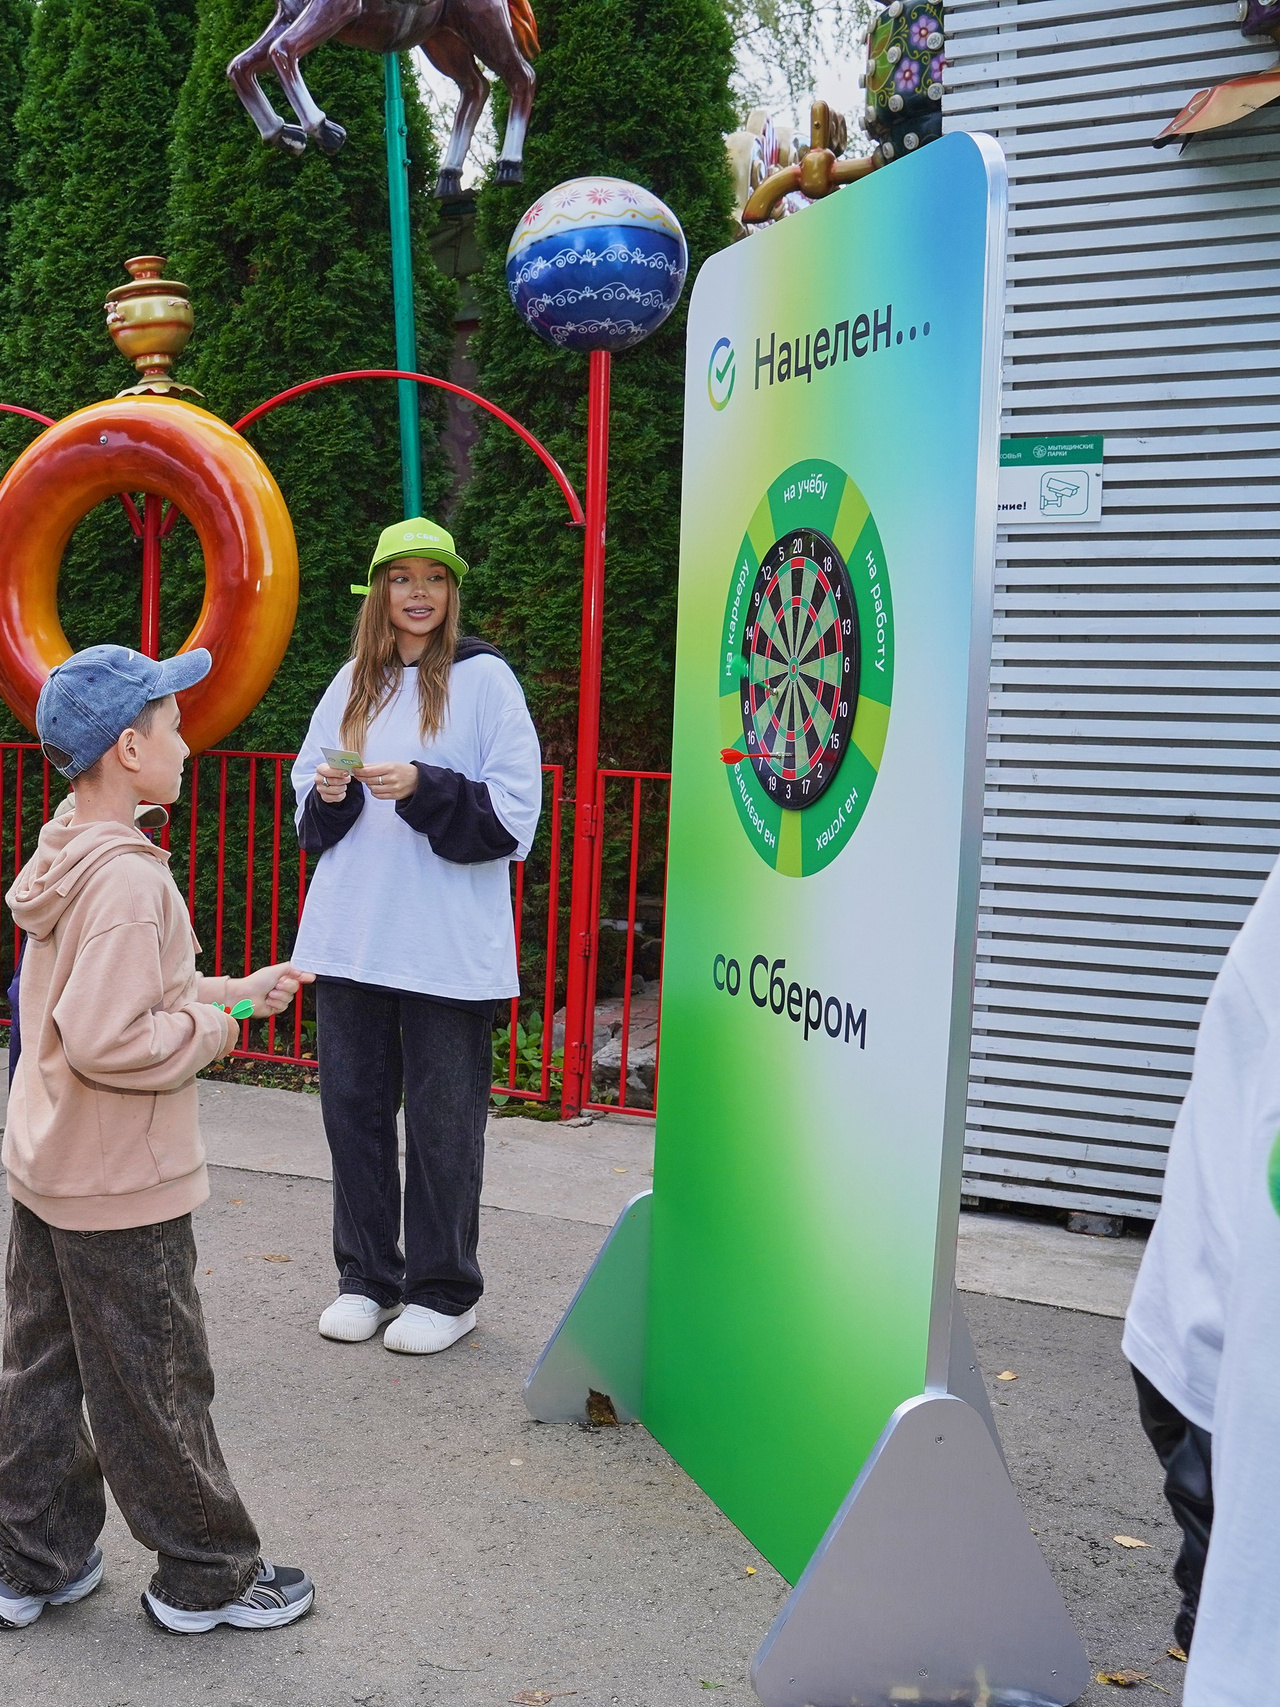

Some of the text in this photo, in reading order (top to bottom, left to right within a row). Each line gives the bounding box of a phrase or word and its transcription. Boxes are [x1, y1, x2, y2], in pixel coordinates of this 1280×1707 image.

[754, 303, 931, 391] Нацелен...
[1047, 443, 1094, 451] МЫТИЩИНСКИЕ
[783, 473, 828, 503] на учёбу
[778, 546, 785, 562] 5
[792, 538, 803, 554] 20
[810, 541, 815, 557] 1
[823, 556, 833, 573] 18
[761, 565, 772, 581] 12
[754, 592, 760, 607] 9
[835, 585, 841, 600] 4
[725, 559, 749, 676] на карьеру
[865, 550, 887, 672] на работу
[745, 625, 754, 641] 14
[842, 618, 852, 636] 13
[844, 656, 850, 673] 6
[744, 700, 750, 715] 8
[838, 701, 848, 718] 10
[747, 730, 755, 745] 16
[830, 732, 840, 750] 15
[758, 757, 764, 771] 7
[817, 762, 823, 779] 2
[768, 775, 777, 791] 19
[801, 779, 811, 795] 17
[786, 784, 792, 799] 3
[733, 762, 776, 849] на результа
[815, 787, 859, 851] на успех
[713, 953, 867, 1050] со Сбером
